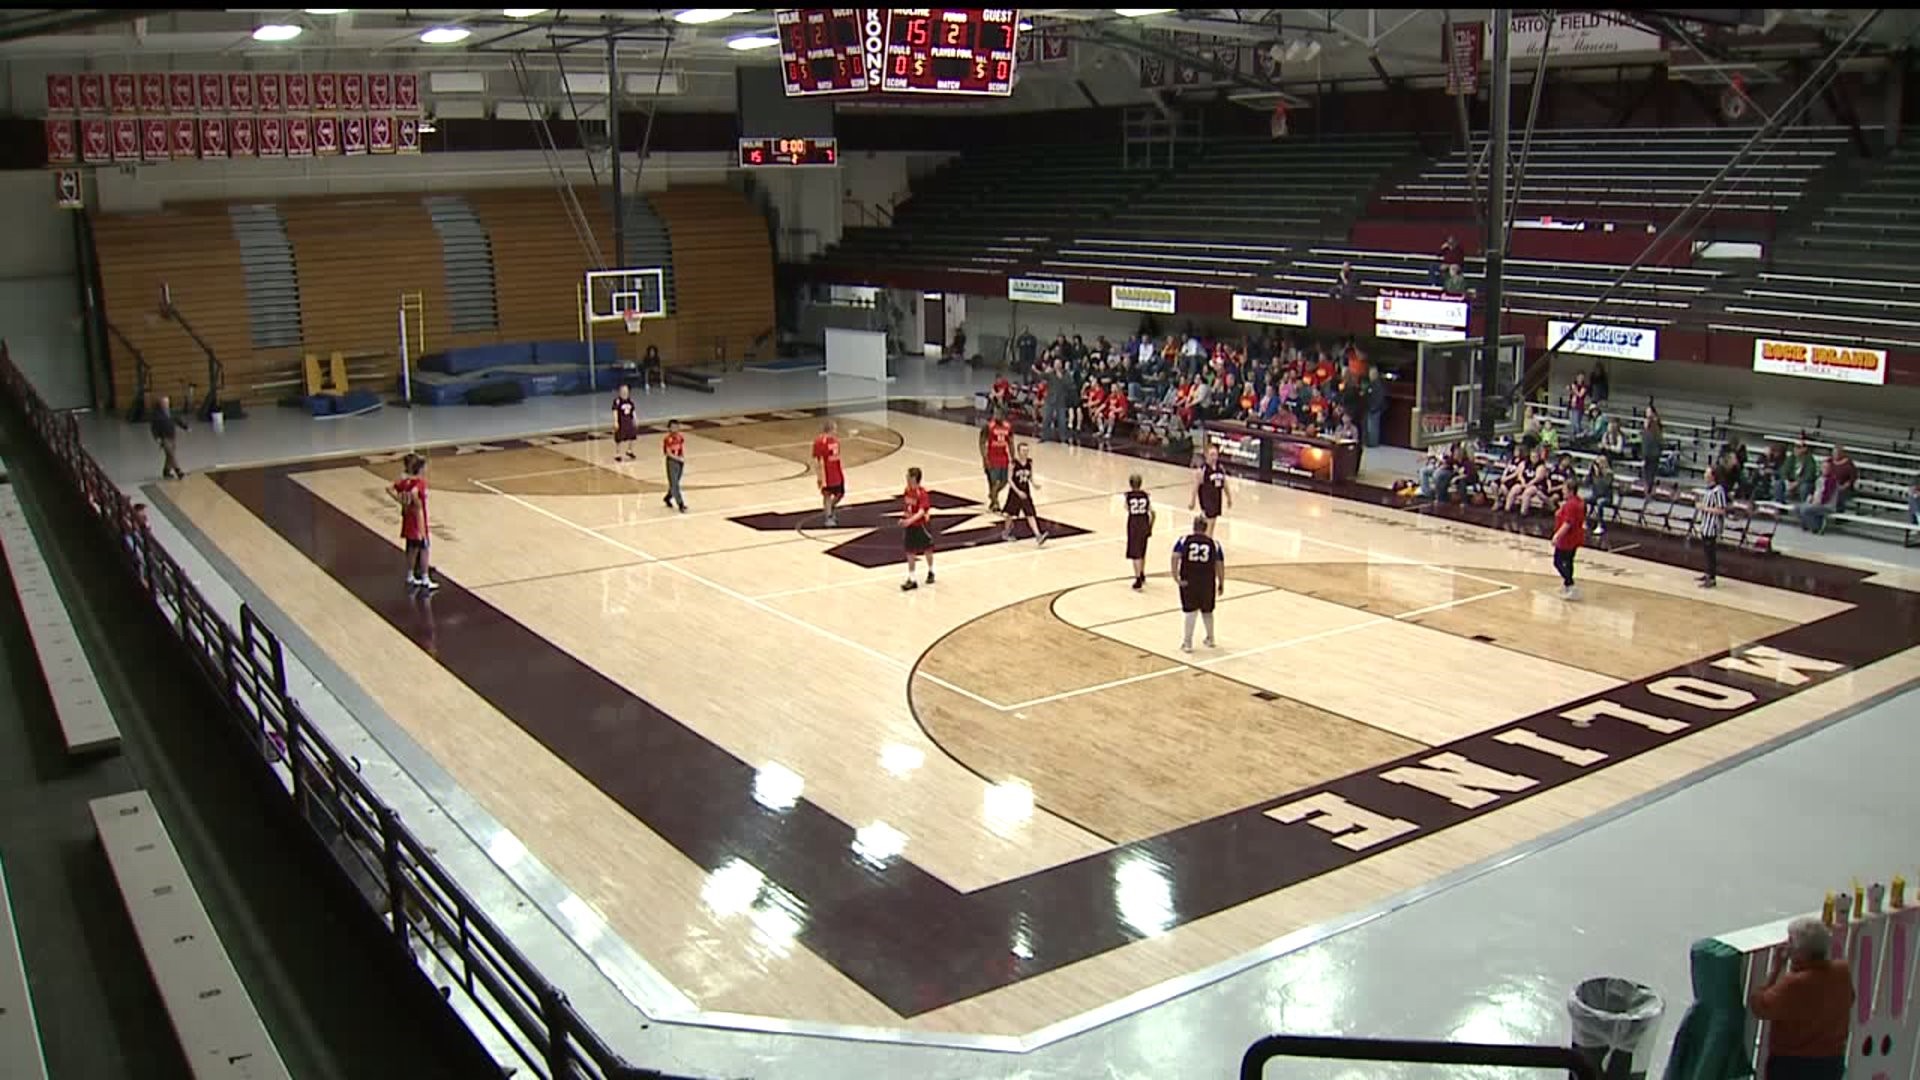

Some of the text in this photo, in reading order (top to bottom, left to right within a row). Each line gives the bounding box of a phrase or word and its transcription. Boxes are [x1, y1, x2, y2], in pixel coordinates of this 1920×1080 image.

[907, 19, 926, 44] 15
[1561, 13, 1600, 31] FIELD
[947, 23, 960, 44] 2
[1001, 25, 1012, 48] 7
[895, 55, 907, 75] 0
[996, 61, 1007, 80] 0
[1762, 342, 1879, 371] ROCK ISLAND
[1129, 497, 1148, 515] 22
[1188, 542, 1210, 562] 23
[1262, 645, 1844, 852] MOLINE
